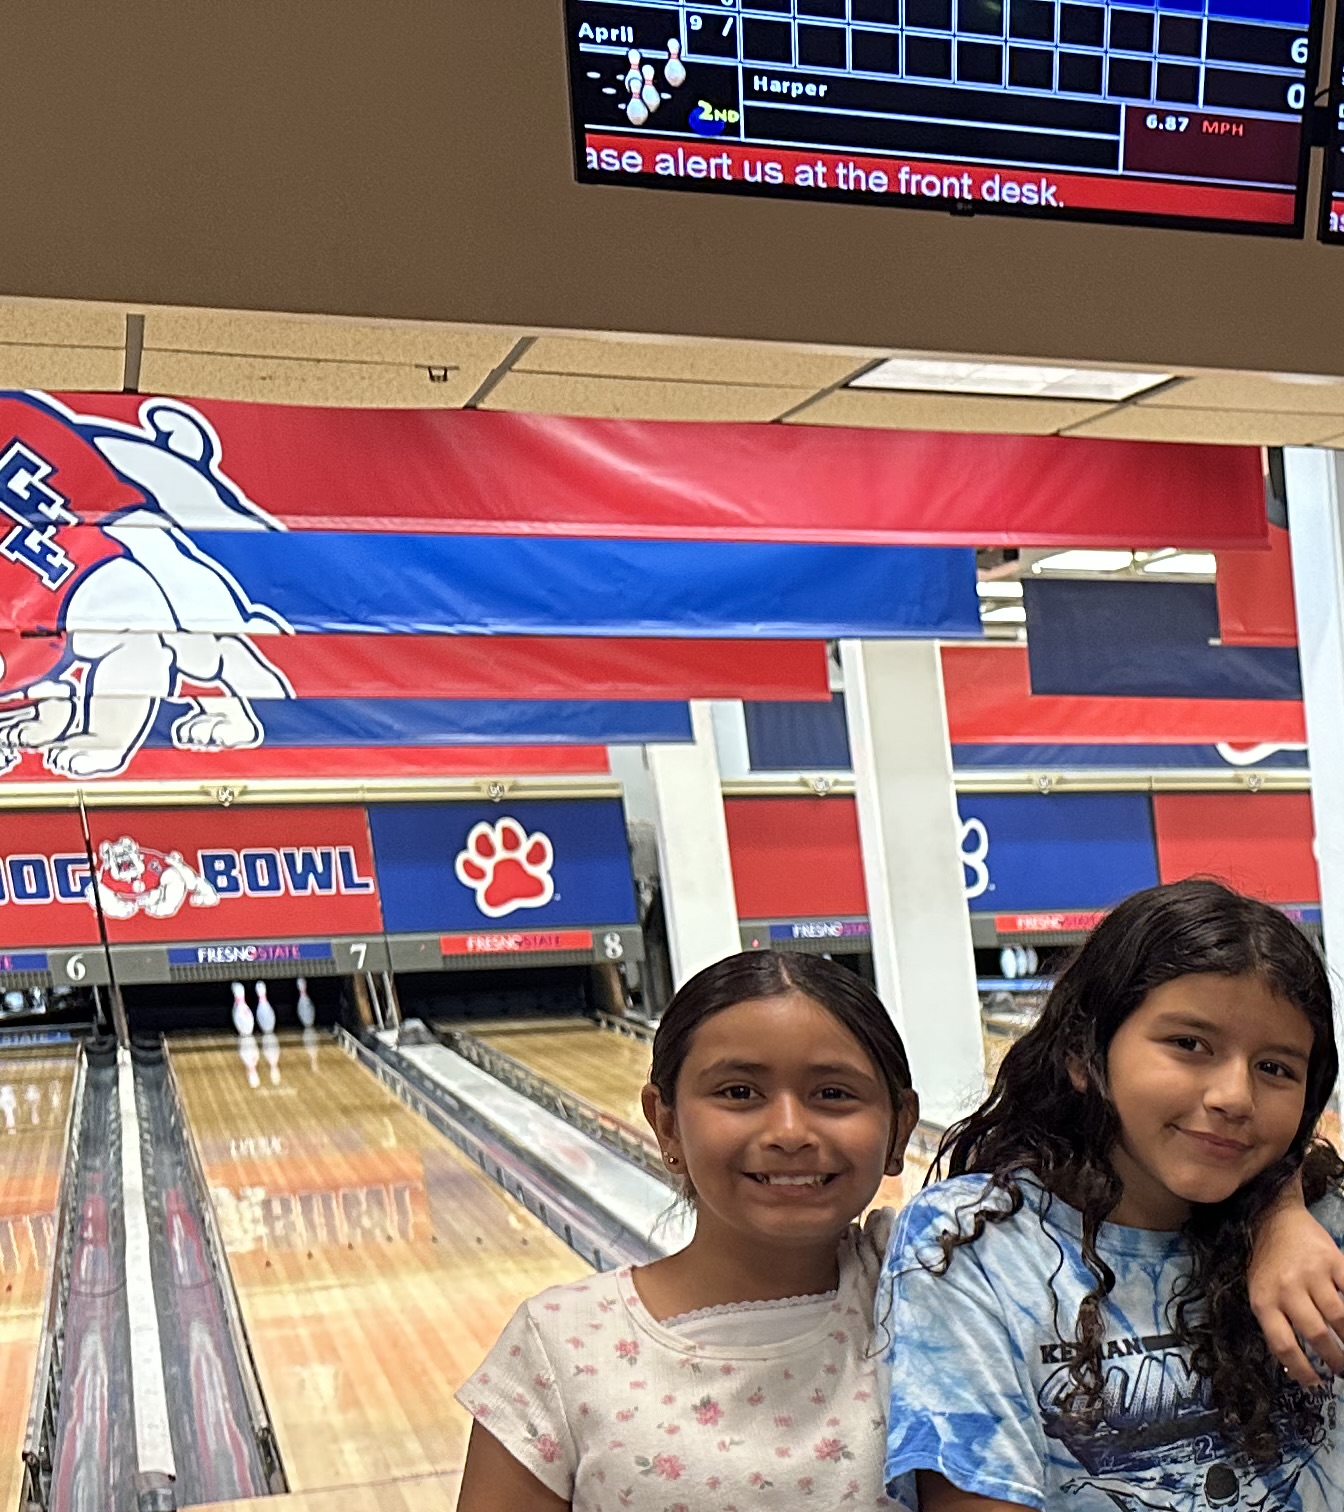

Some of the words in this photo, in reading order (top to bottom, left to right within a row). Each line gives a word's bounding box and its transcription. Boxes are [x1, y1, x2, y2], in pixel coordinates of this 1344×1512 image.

[1290, 37, 1309, 64] 6
[578, 22, 634, 44] April
[1286, 83, 1305, 109] 0
[753, 75, 829, 98] Harper
[1145, 114, 1189, 132] 6.87
[1202, 120, 1244, 137] MPH
[654, 147, 732, 181] alert
[743, 160, 784, 185] us
[795, 164, 830, 190] at
[836, 161, 888, 193] the
[900, 166, 973, 201] front
[980, 174, 1065, 208] desk.
[0, 853, 97, 905] OG
[199, 846, 375, 898] BOWL
[350, 943, 368, 970] 7
[603, 932, 624, 959] 8
[66, 953, 86, 981] 6
[1040, 1337, 1144, 1365] KEAN
